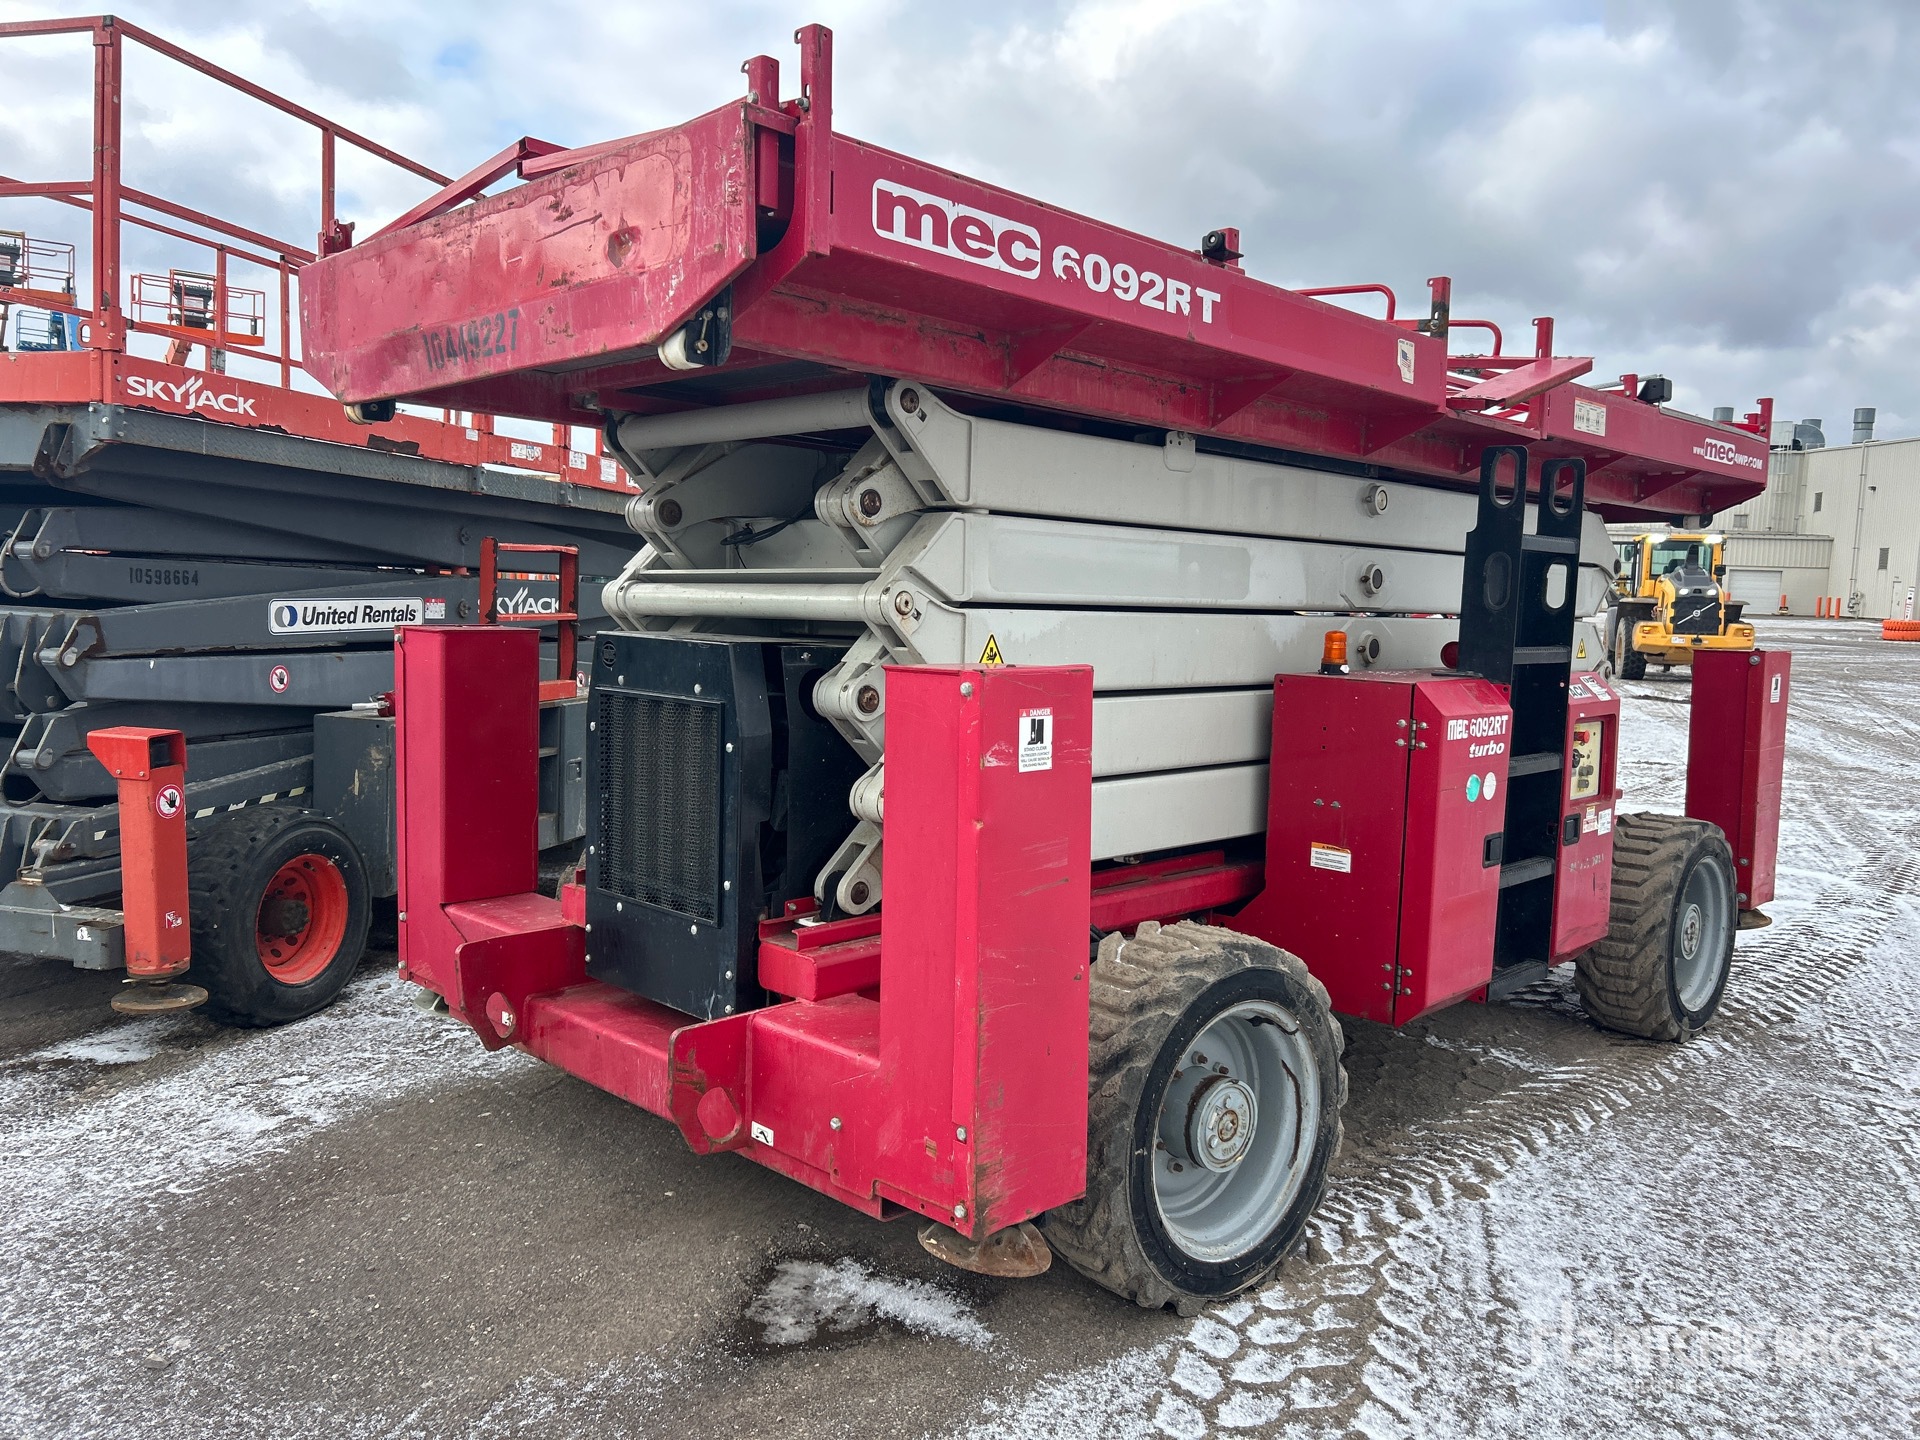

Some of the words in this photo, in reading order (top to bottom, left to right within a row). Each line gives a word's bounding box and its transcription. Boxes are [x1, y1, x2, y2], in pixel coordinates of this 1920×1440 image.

[875, 186, 1041, 273] mec
[1052, 245, 1221, 325] 6092RT
[126, 375, 257, 417] SKYJACK
[129, 567, 199, 586] 10598664
[302, 606, 358, 625] United
[362, 604, 416, 624] Rentals
[1030, 708, 1051, 717] DANGER
[1470, 715, 1509, 738] 6092RT
[1469, 740, 1505, 758] turbo
